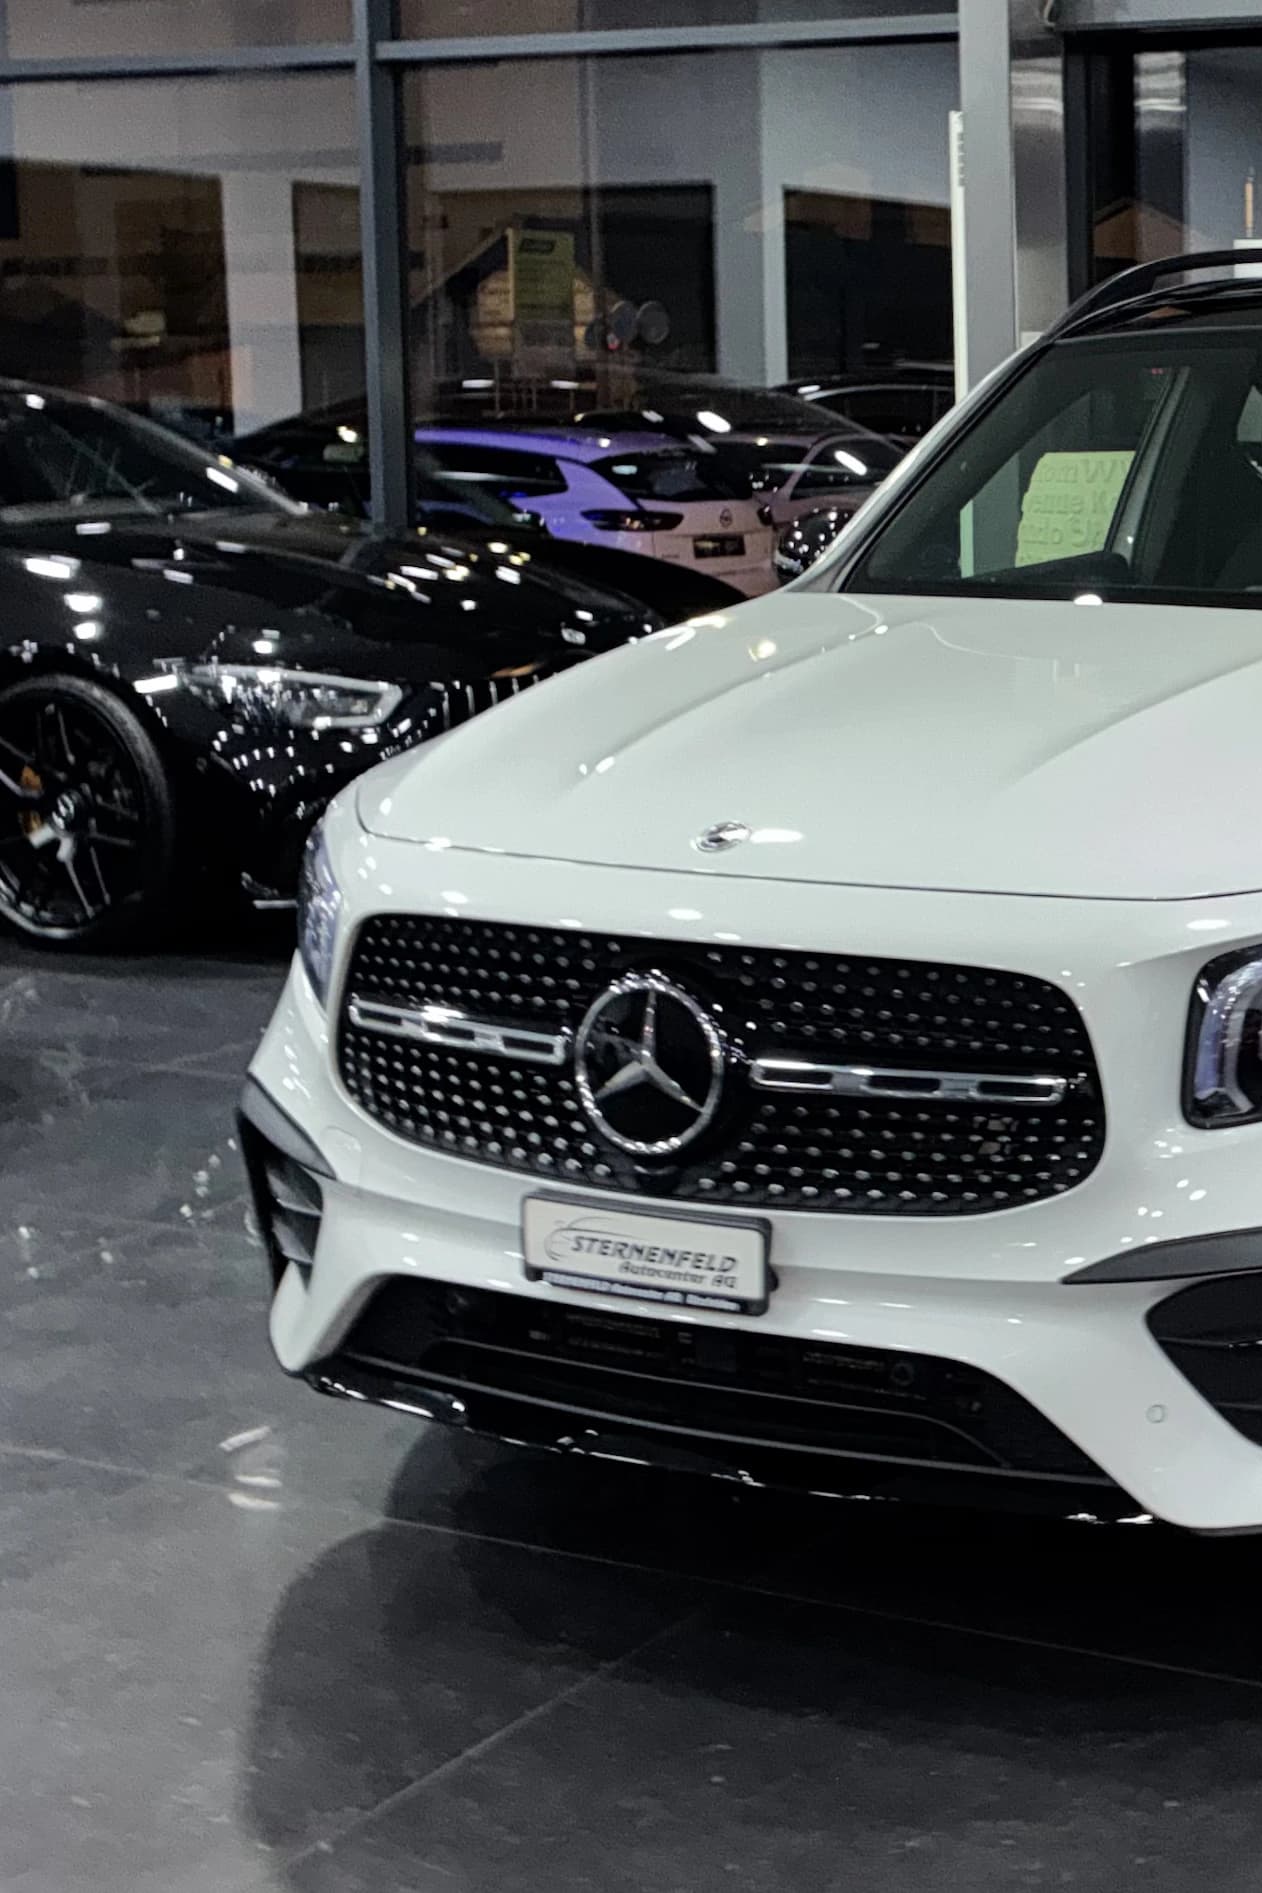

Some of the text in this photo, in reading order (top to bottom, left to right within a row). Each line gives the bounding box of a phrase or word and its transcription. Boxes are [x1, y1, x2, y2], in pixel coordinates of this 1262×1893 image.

[571, 1235, 738, 1273] STERNENFELD
[619, 1261, 737, 1289] Autocenter AG
